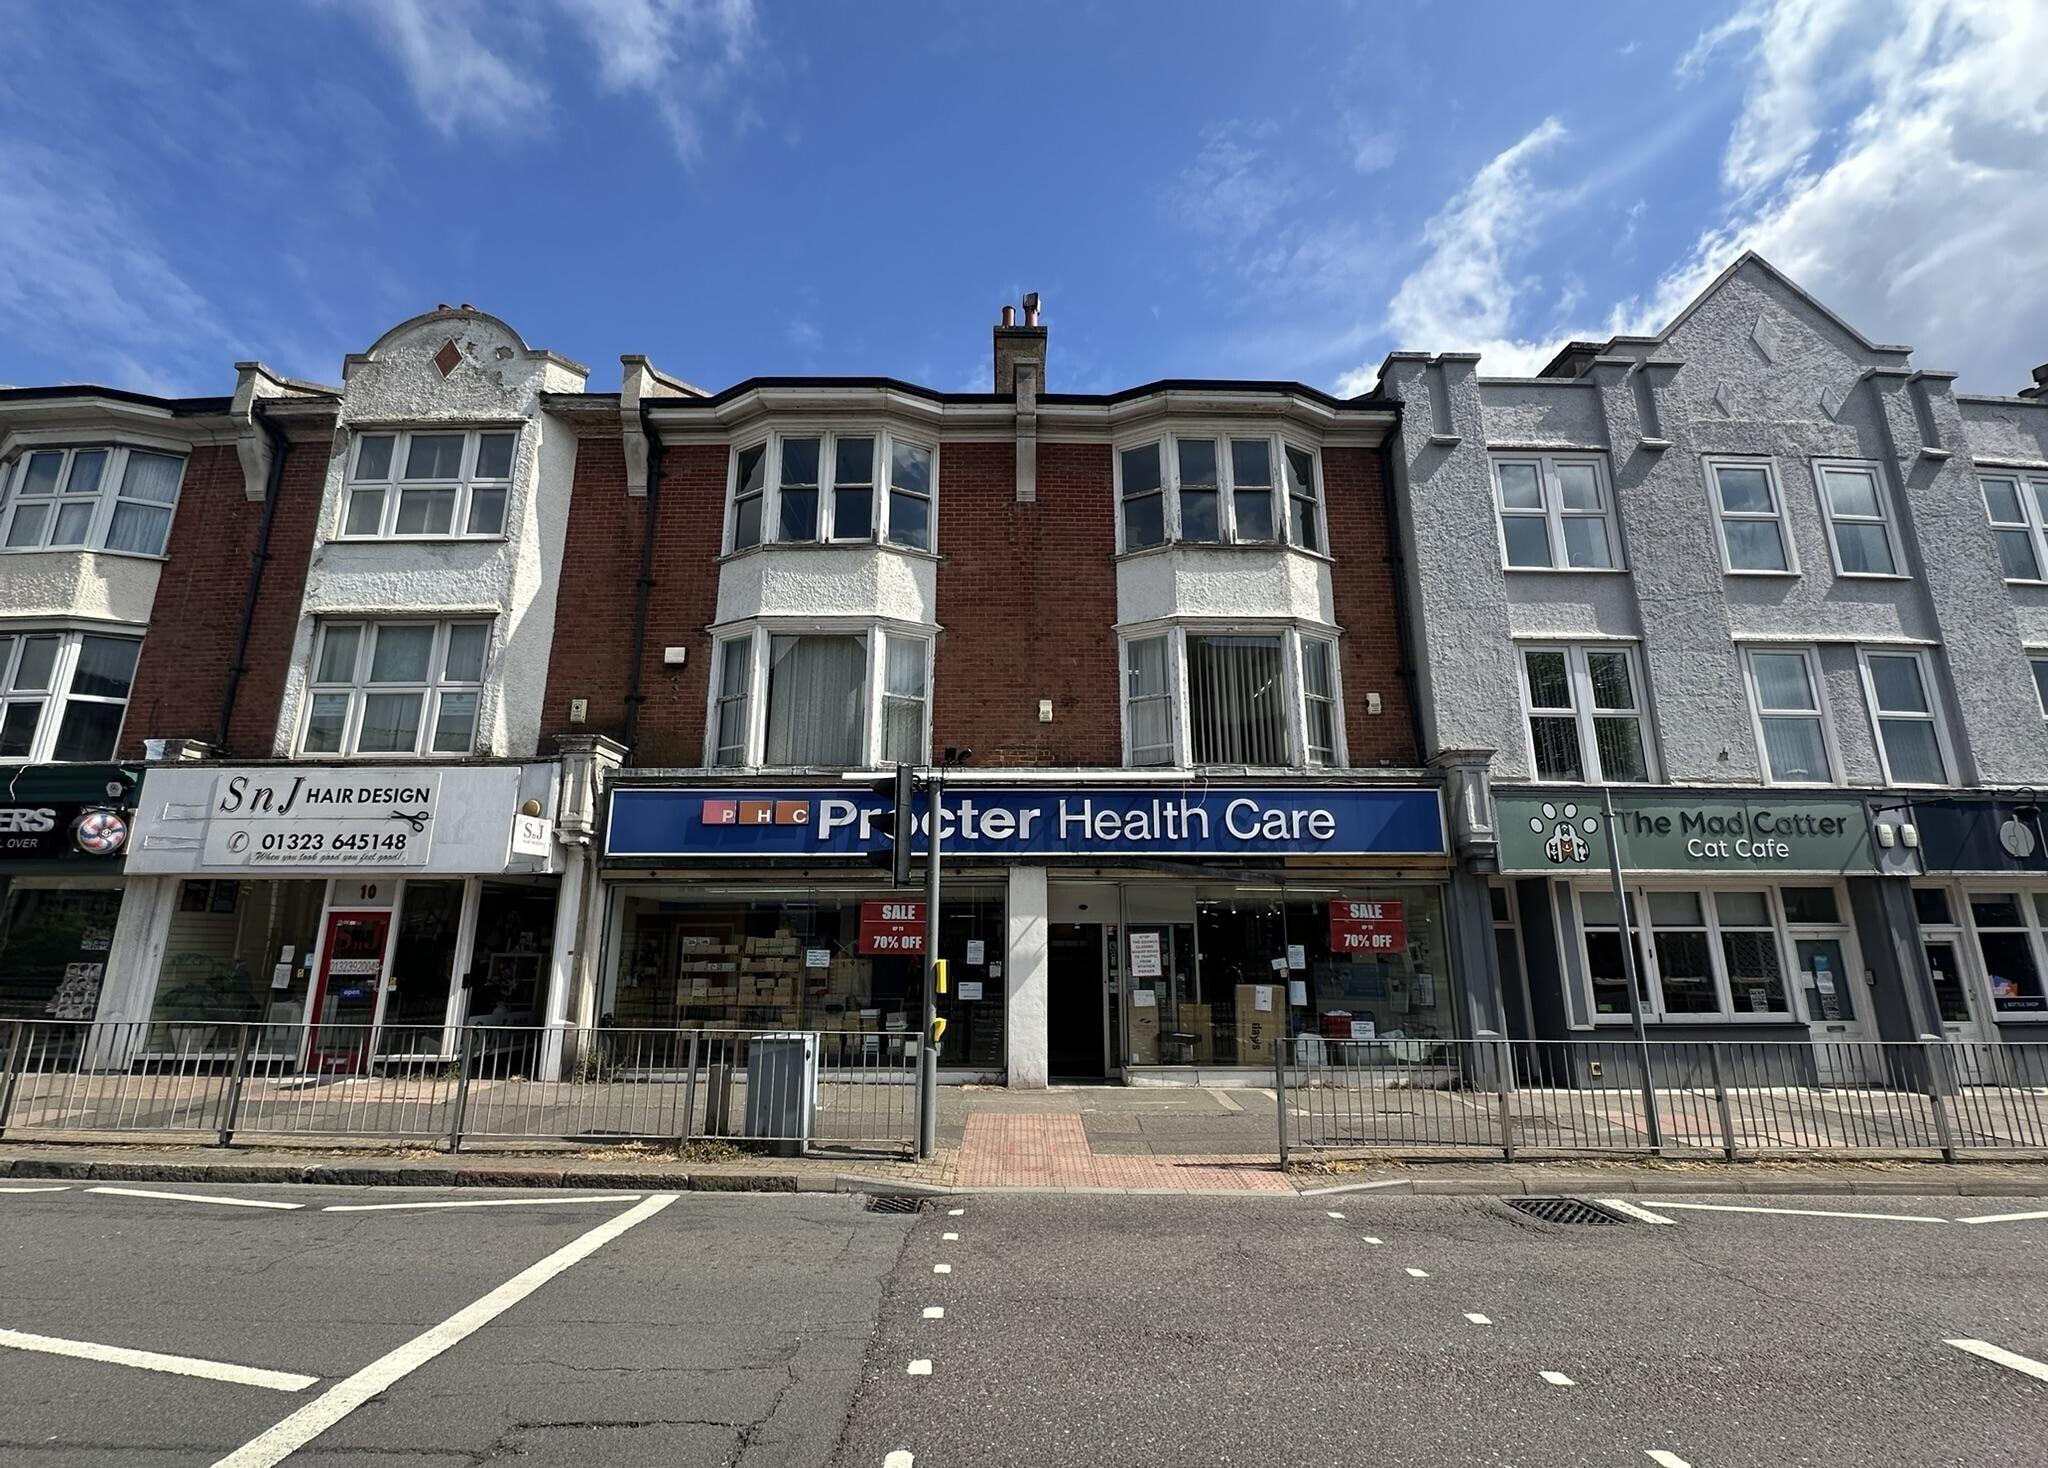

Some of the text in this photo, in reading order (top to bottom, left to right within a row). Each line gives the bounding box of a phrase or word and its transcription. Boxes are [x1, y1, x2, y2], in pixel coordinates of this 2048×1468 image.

[306, 788, 353, 804] HAIR
[358, 788, 430, 804] DESIGN
[1059, 798, 1209, 840] Health
[1225, 798, 1336, 840] Care
[1613, 810, 1847, 836] The Mad Catter
[7, 839, 39, 848] OVER
[262, 833, 407, 850] 01323 645148
[1687, 838, 1790, 858] Cat Cafe
[360, 884, 377, 900] 10
[881, 904, 916, 920] SALE
[1349, 903, 1384, 919] SALE
[873, 935, 923, 949] 70% OFF
[1343, 934, 1393, 948] 70% OFF
[343, 989, 360, 998] open
